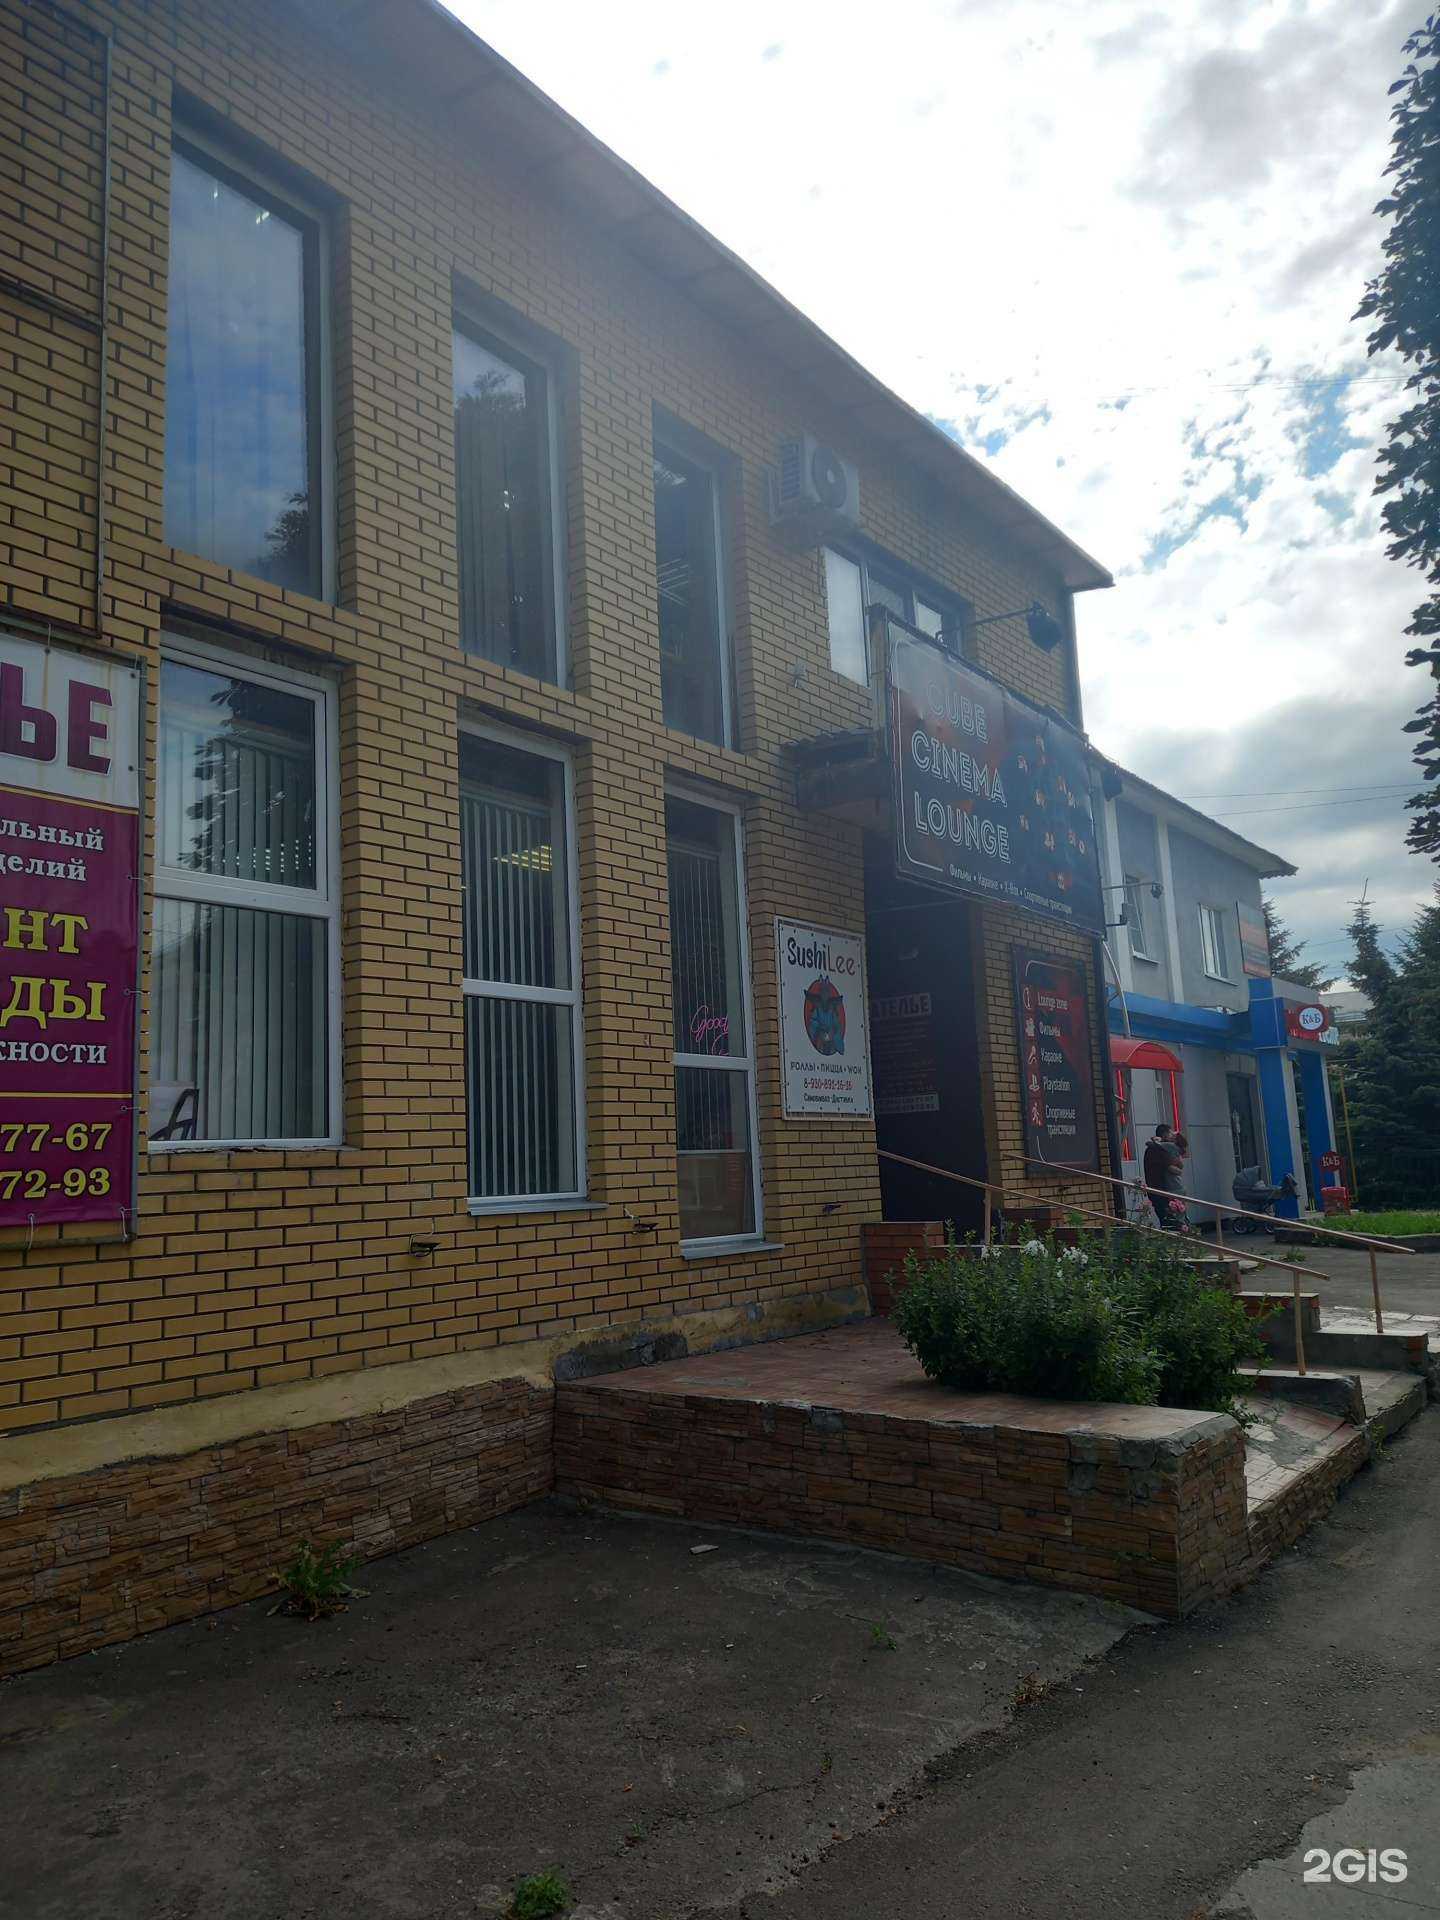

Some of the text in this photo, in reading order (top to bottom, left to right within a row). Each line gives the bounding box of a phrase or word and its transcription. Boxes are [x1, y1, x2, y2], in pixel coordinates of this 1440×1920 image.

[927, 681, 989, 744] CUBE
[911, 729, 1007, 807] CINEMA
[914, 791, 1011, 864] LOUNGE
